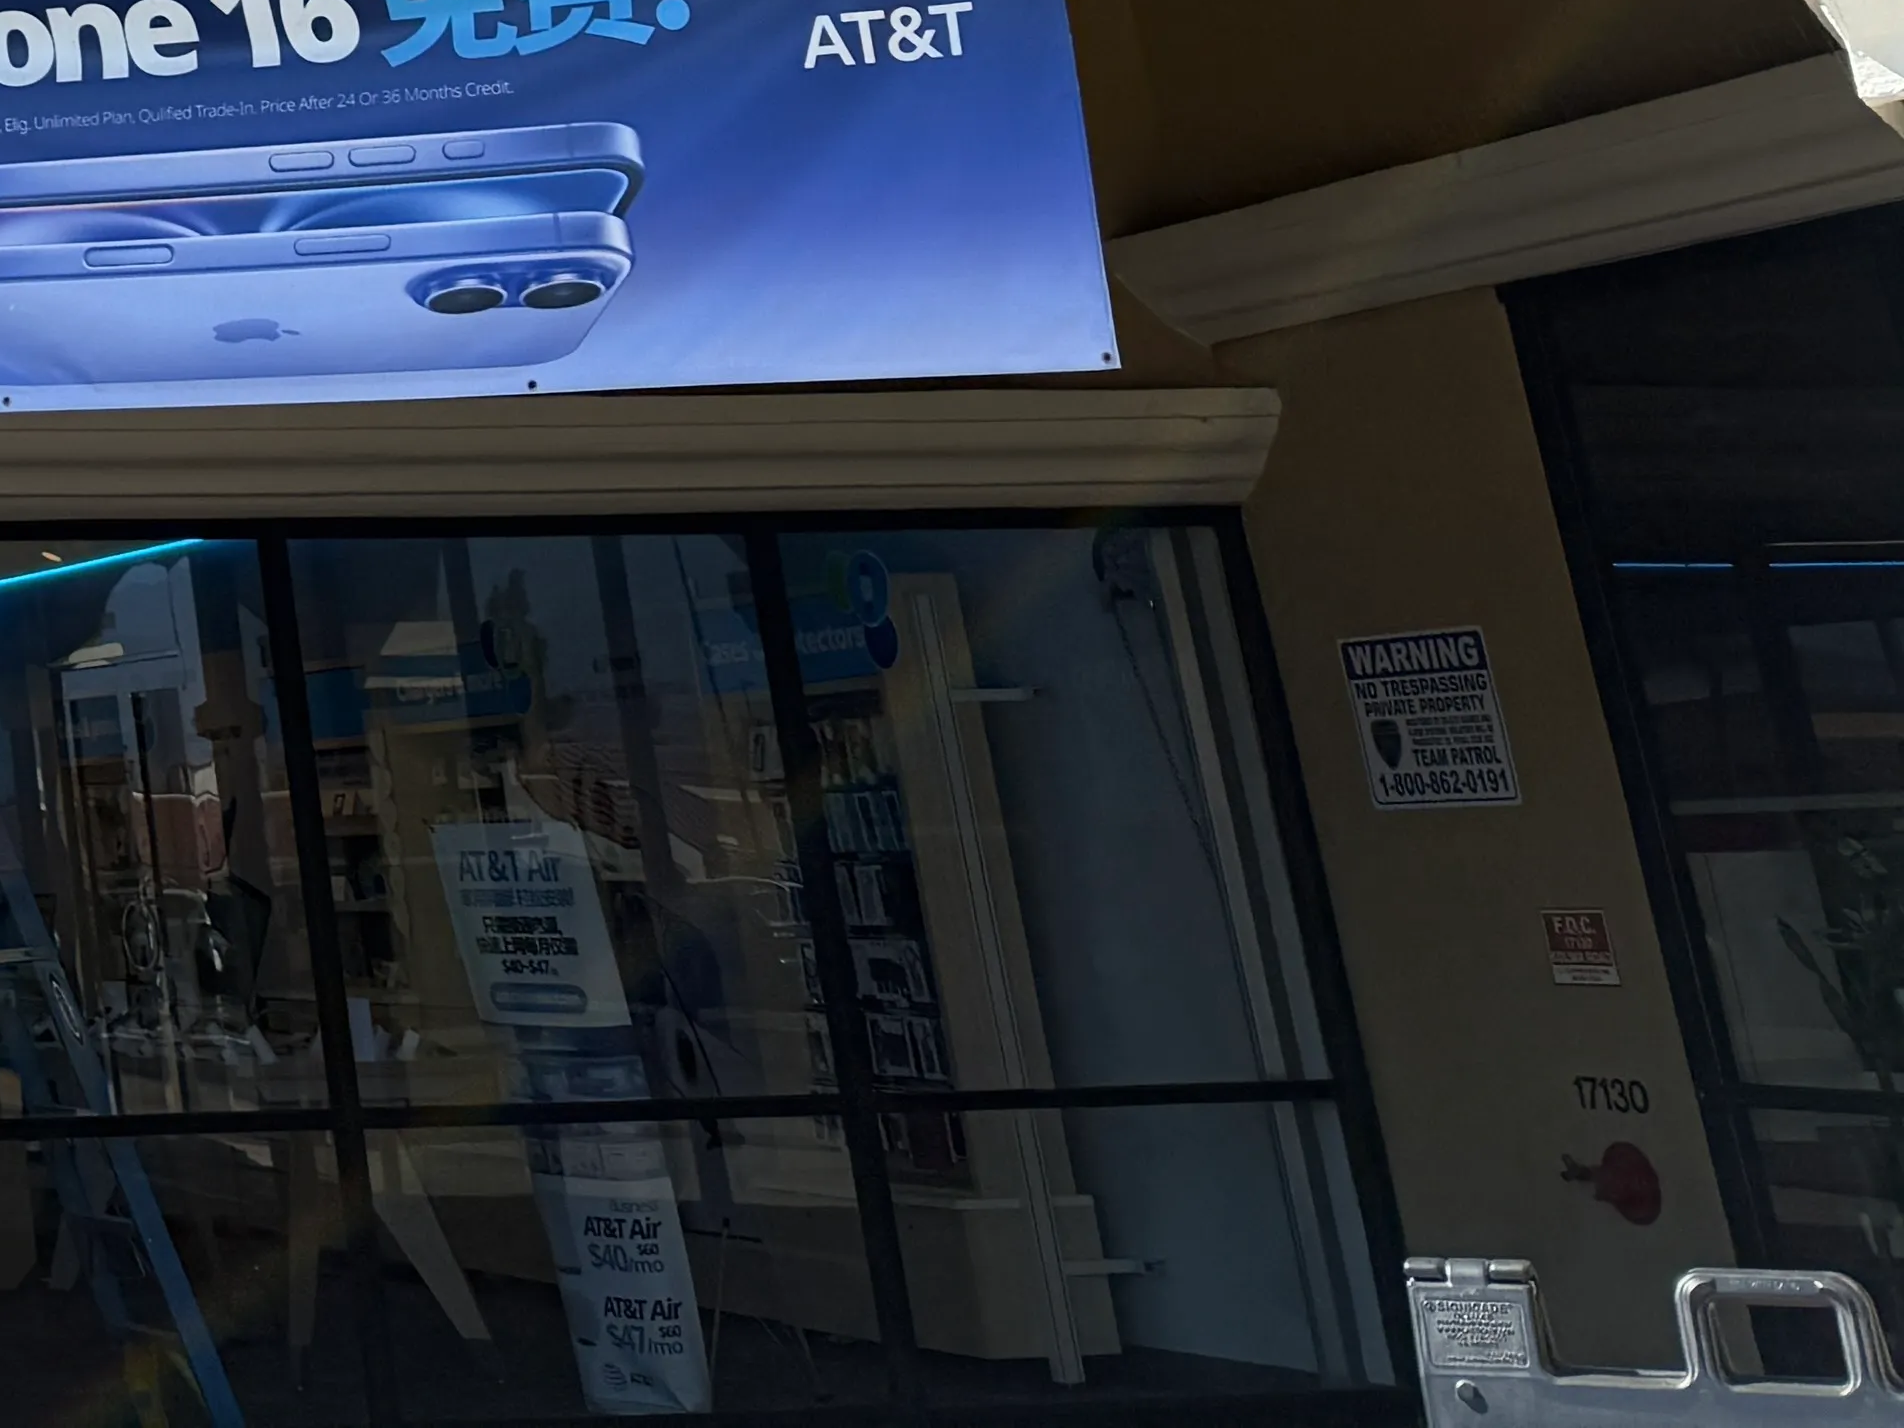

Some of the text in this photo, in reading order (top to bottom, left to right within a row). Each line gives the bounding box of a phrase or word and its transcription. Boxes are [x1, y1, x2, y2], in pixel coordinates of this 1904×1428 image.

[803, 1, 974, 71] AT&T
[34, 111, 100, 131] Unlimited
[260, 97, 297, 113] Price
[299, 93, 334, 111] After
[336, 93, 356, 109] 24
[358, 91, 378, 106] Or
[382, 89, 402, 104] 36
[404, 84, 462, 102] Months
[1347, 635, 1480, 676] WARNING
[1354, 673, 1488, 700] NO TRESPASSING
[1364, 694, 1486, 717] PRIVATE PROPERTY
[1412, 745, 1502, 767] TEAM PATROL
[1379, 768, 1510, 798] 1-800-862-0191
[459, 850, 519, 882] AT&T
[1573, 1075, 1649, 1114] 17130
[584, 1215, 663, 1240] AT&T Air
[604, 1296, 682, 1321] AT&T Air
